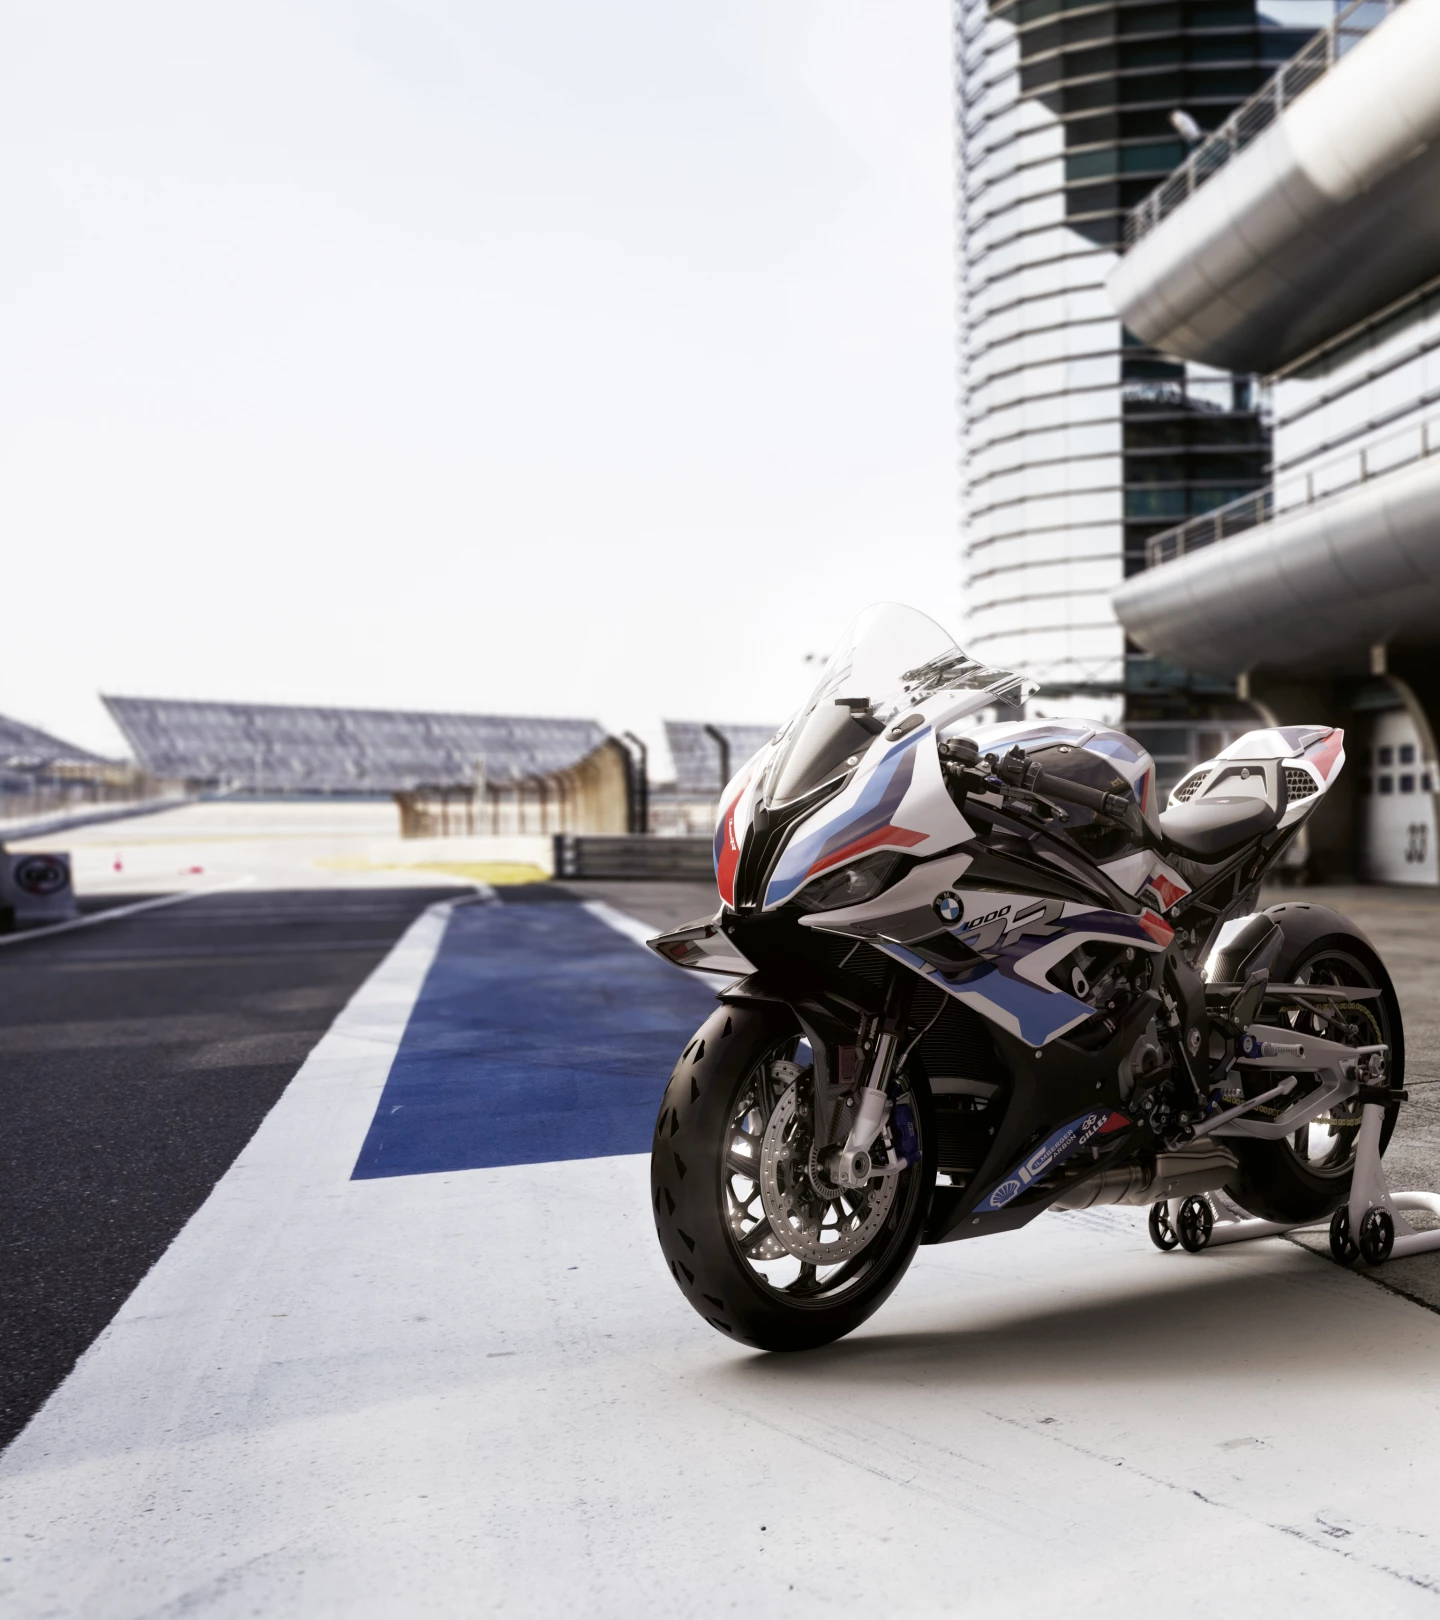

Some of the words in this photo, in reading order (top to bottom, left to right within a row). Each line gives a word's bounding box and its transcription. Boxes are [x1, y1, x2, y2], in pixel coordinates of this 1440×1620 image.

[962, 904, 1012, 931] 1000
[1078, 1114, 1108, 1145] GILLES
[1034, 1129, 1074, 1168] ILMBERGER
